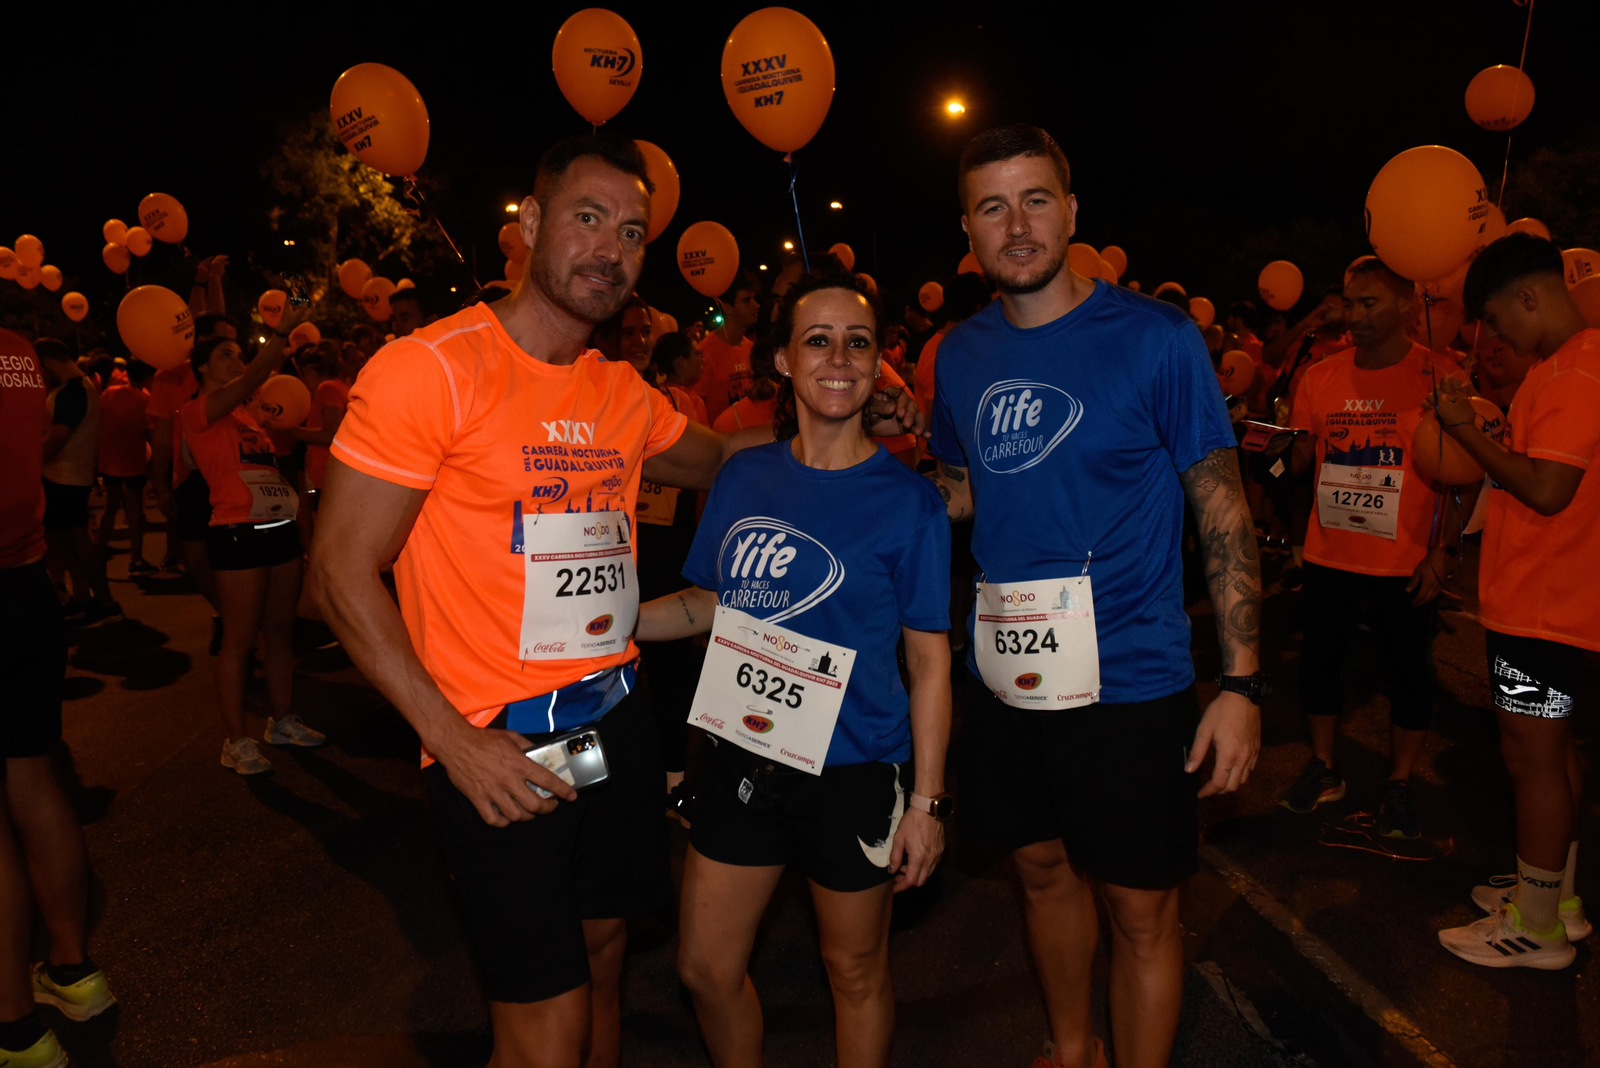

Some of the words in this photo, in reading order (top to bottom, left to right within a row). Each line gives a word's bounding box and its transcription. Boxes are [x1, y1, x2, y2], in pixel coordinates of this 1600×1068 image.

[741, 54, 786, 76] XXXV
[738, 74, 803, 94] GUADALQUIVIR
[336, 107, 362, 130] XXXV
[684, 250, 706, 260] XXXV
[1343, 399, 1385, 411] XXXV
[1330, 418, 1397, 426] GUADALQUIVIR
[541, 419, 595, 445] XXXV
[1011, 431, 1028, 441] HACES
[522, 445, 569, 457] CARRERA
[571, 448, 621, 458] NOCTURNA
[984, 435, 1044, 462] CARREFOUR
[523, 456, 531, 472] DEL
[533, 457, 625, 472] GUADALQUIVIR
[259, 486, 291, 497] 19219
[640, 480, 662, 495] 38
[1332, 490, 1384, 509] 12726
[556, 562, 625, 597] 22531
[751, 580, 770, 590] HACES
[722, 589, 790, 608] CARREFOUR
[995, 628, 1059, 654] 6324
[731, 642, 751, 655] CARRERA
[750, 649, 774, 664] NOCTURNA
[781, 663, 816, 681] GUADALQUIVIR
[825, 679, 839, 688] 2023
[736, 662, 805, 710] 6325
[1057, 691, 1093, 702] Cruzcampo
[781, 748, 816, 766] Cruzcampo
[1520, 870, 1562, 889] VANS
